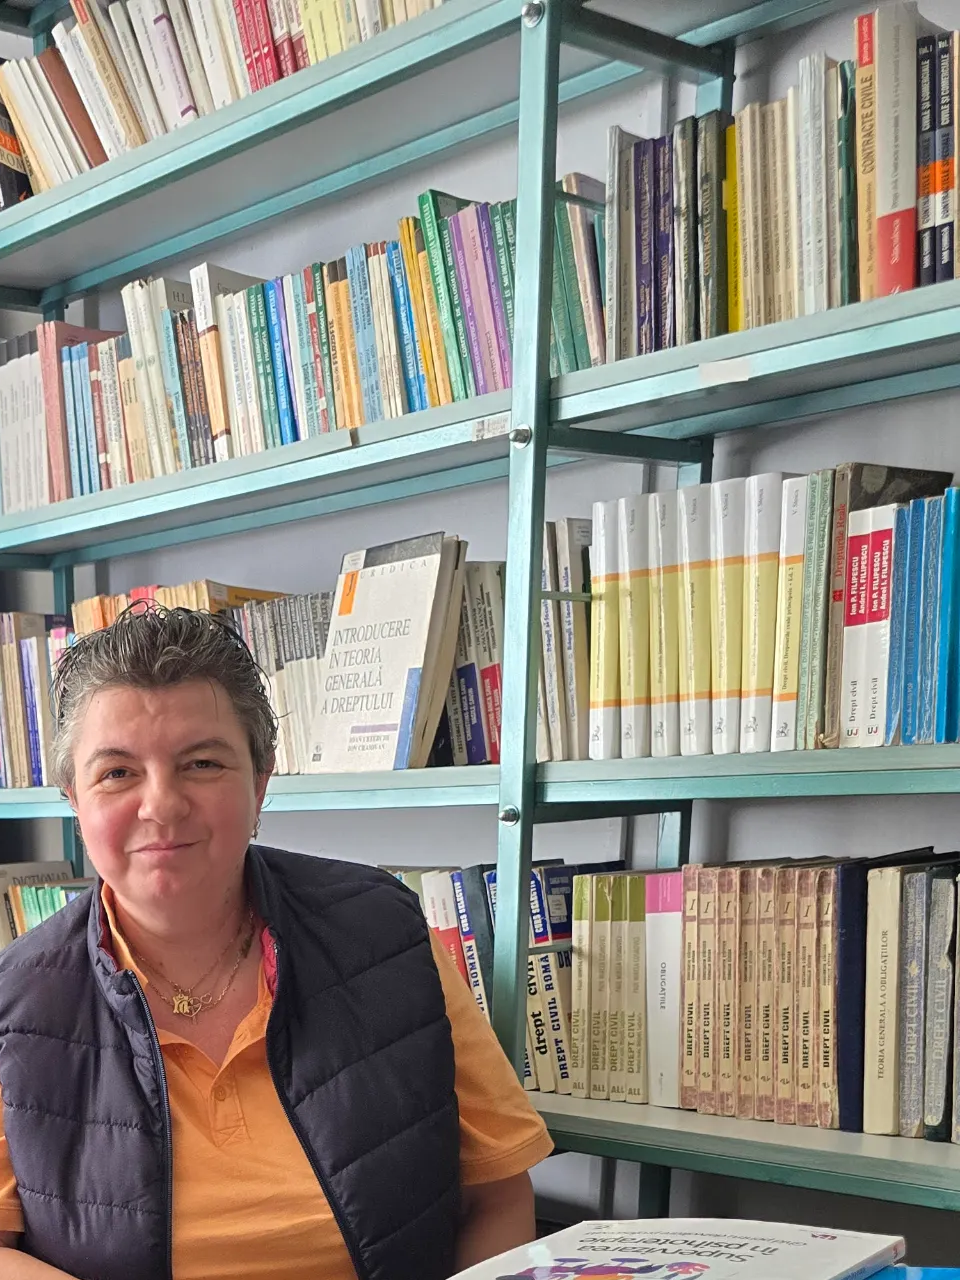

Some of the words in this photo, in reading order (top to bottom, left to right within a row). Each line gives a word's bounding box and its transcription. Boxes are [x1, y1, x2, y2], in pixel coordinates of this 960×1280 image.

[939, 53, 949, 95] COMERCIALE
[859, 75, 873, 109] CIVILE
[921, 110, 932, 131] CIVILE
[940, 104, 950, 125] CIVILE
[861, 112, 875, 174] CONTRACTE
[701, 181, 711, 214] CIVILE
[422, 203, 436, 240] DREPTULUI
[442, 229, 454, 266] DREPTULUI
[701, 215, 711, 276] CONTRACTE
[392, 248, 403, 287] DREPTULUI
[268, 289, 278, 324] DREPTULUI
[455, 306, 461, 317] DE
[457, 319, 468, 358] COMPENDIU
[836, 503, 846, 529] Reale
[835, 531, 845, 578] Drepturile
[860, 545, 868, 583] FILIPESCU
[881, 540, 890, 578] FILIPESCU
[851, 556, 859, 594] FILIPESCU
[872, 551, 881, 590] FILIPESCU
[849, 603, 857, 615] Ion
[858, 592, 866, 614] Andrei
[333, 619, 411, 647] INTRODUCERE
[329, 650, 341, 669] ÎN
[342, 648, 382, 667] TEORIA
[325, 666, 382, 692] GENERALĂ
[849, 680, 857, 697] civil
[870, 677, 878, 694] civil
[321, 702, 328, 715] A
[330, 692, 394, 714] DREPTULUI
[849, 699, 859, 722] Drept
[869, 697, 879, 720] Drept
[454, 880, 466, 914] SELECTIV
[459, 915, 470, 932] CURS
[532, 915, 544, 933] CURS
[465, 944, 479, 987] ROMAN
[880, 992, 887, 1000] A
[906, 984, 918, 1020] CIVIL
[934, 977, 946, 1014] CIVIL
[548, 997, 561, 1031] CIVIL
[572, 1008, 580, 1031] CIVIL
[592, 1010, 601, 1036] CIVIL
[610, 1011, 618, 1037] CIVIL
[627, 1012, 635, 1039] CIVIL
[744, 1004, 752, 1029] CIVIL
[762, 1004, 771, 1029] CIVIL
[782, 1006, 790, 1031] CIVIL
[802, 1010, 810, 1036] CIVIL
[531, 1011, 548, 1055] drept
[686, 1026, 694, 1056] DREPT
[702, 1029, 711, 1058] DREPT
[722, 1030, 730, 1059] DREPT
[744, 1032, 752, 1061] DREPT
[762, 1032, 770, 1061] DREPT
[905, 1023, 918, 1064] DREPT
[932, 1017, 945, 1060] DREPT
[554, 1038, 569, 1079] DREPT
[571, 1033, 580, 1068] DREPT
[591, 1039, 601, 1071] DREPT
[609, 1040, 618, 1072] DREPT
[627, 1041, 635, 1074] DREPT
[781, 1033, 790, 1064] DREPT
[802, 1038, 810, 1069] DREPT
[822, 1037, 830, 1068] DREPT
[877, 1048, 885, 1079] TEORIA
[572, 1080, 585, 1091] ALL
[592, 1083, 606, 1093] ALL
[610, 1084, 626, 1095] ALL
[627, 1087, 641, 1096] ALL
[577, 1244, 754, 1263] Supervizarea
[755, 1245, 778, 1256] în
